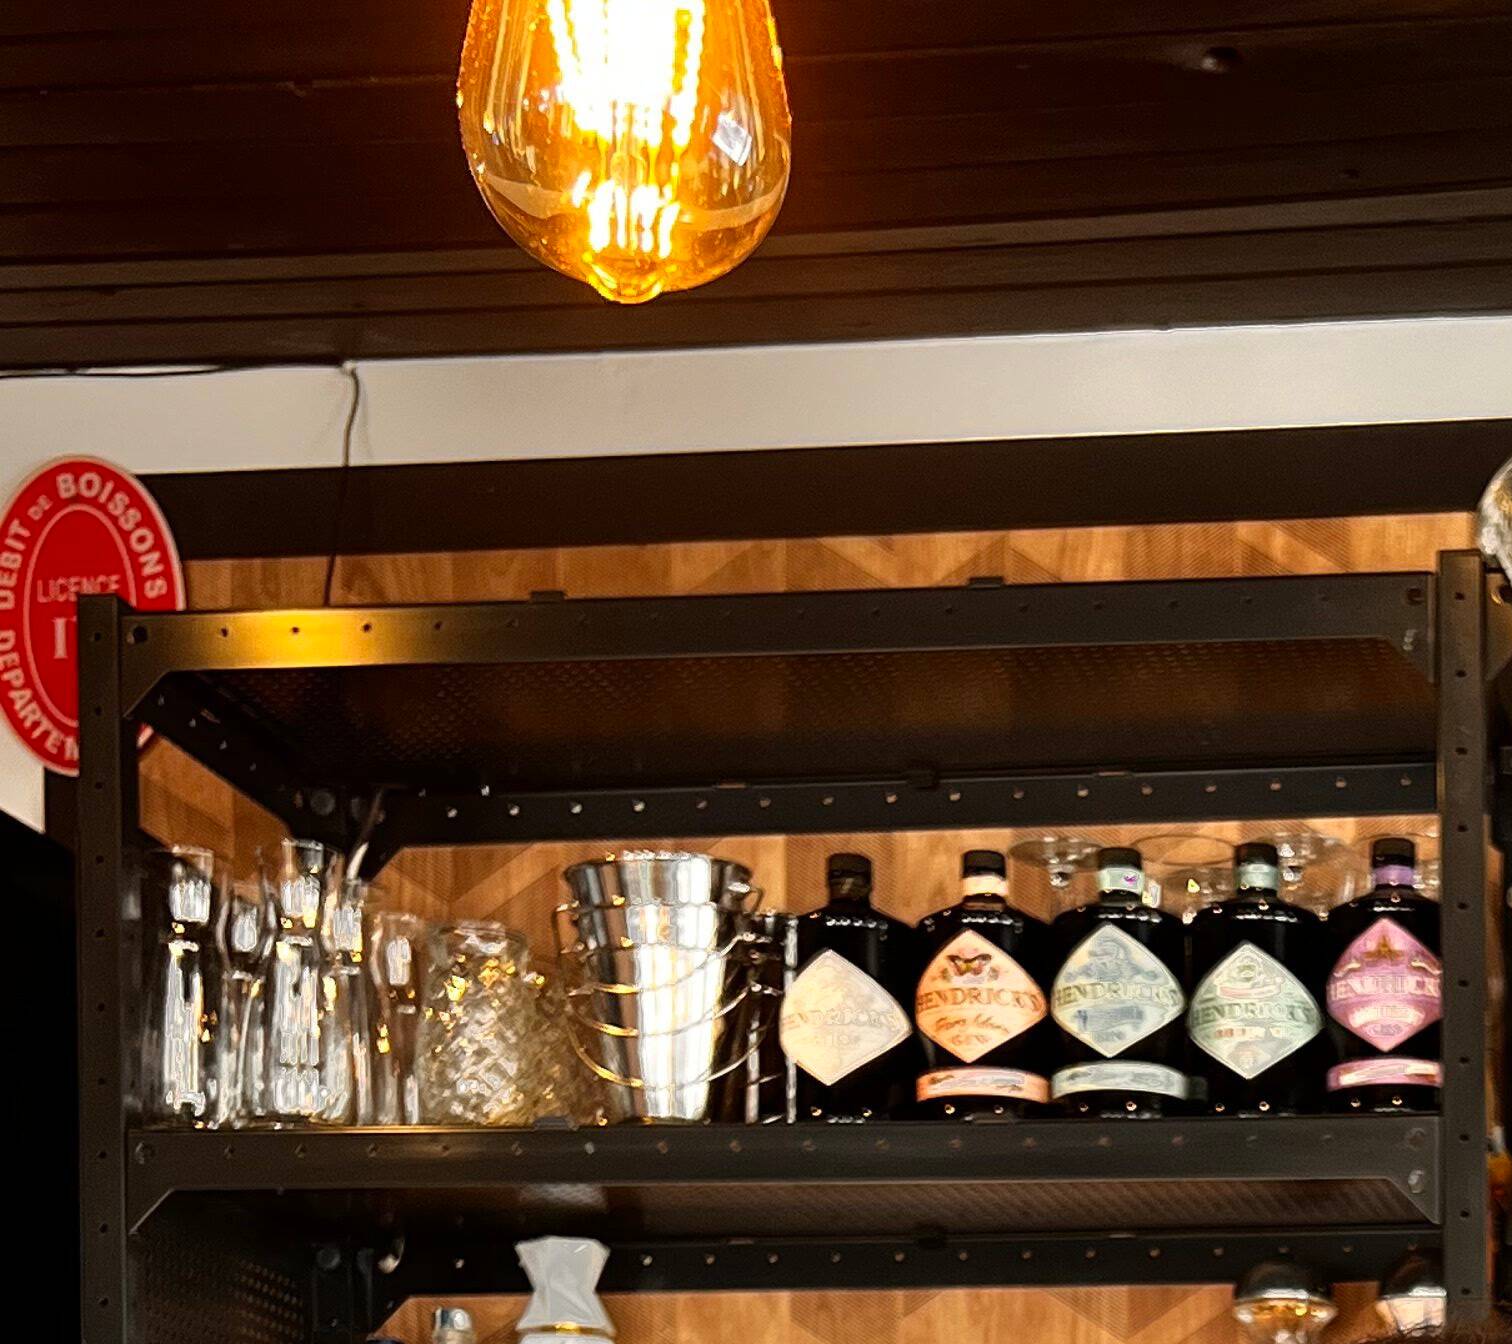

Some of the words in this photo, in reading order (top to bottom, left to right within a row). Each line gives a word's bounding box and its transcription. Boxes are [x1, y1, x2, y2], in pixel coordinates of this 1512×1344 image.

[56, 472, 168, 600] BOISSONS
[37, 574, 121, 603] LICENCE
[52, 616, 78, 660] I
